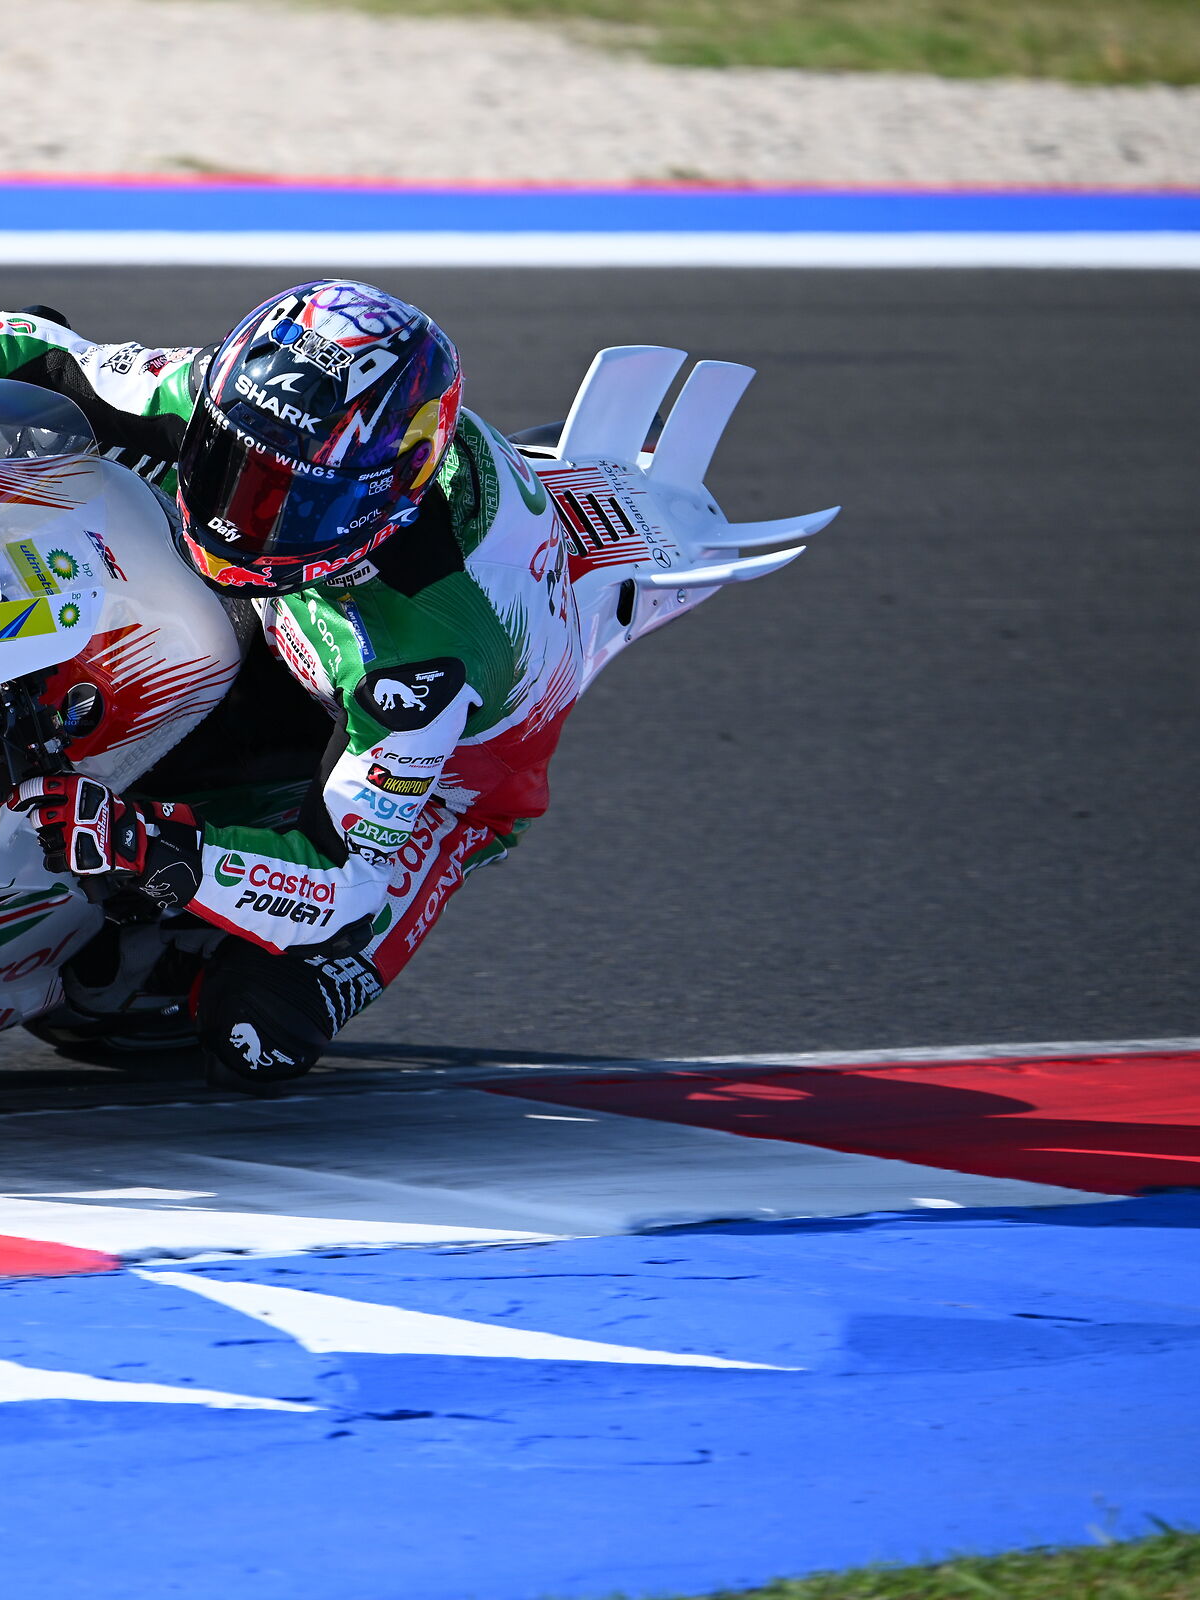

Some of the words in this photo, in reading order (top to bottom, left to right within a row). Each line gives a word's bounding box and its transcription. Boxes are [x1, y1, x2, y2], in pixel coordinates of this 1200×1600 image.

[235, 374, 322, 434] SHARK
[204, 397, 231, 431] GIVES
[236, 429, 266, 455] YOU
[275, 452, 335, 479] WINGS
[358, 466, 393, 481] SHARK
[599, 460, 624, 493] Truck
[207, 516, 241, 543] Dafy
[349, 508, 381, 529] april
[621, 496, 658, 544] Piolanti
[19, 544, 55, 596] ultimate
[81, 562, 94, 578] bp
[71, 592, 82, 600] bp
[283, 616, 317, 668] Castrol
[354, 819, 410, 845] DRACO
[249, 863, 336, 905] Castrol
[405, 826, 489, 953] HONDA
[234, 890, 336, 927] POWER1
